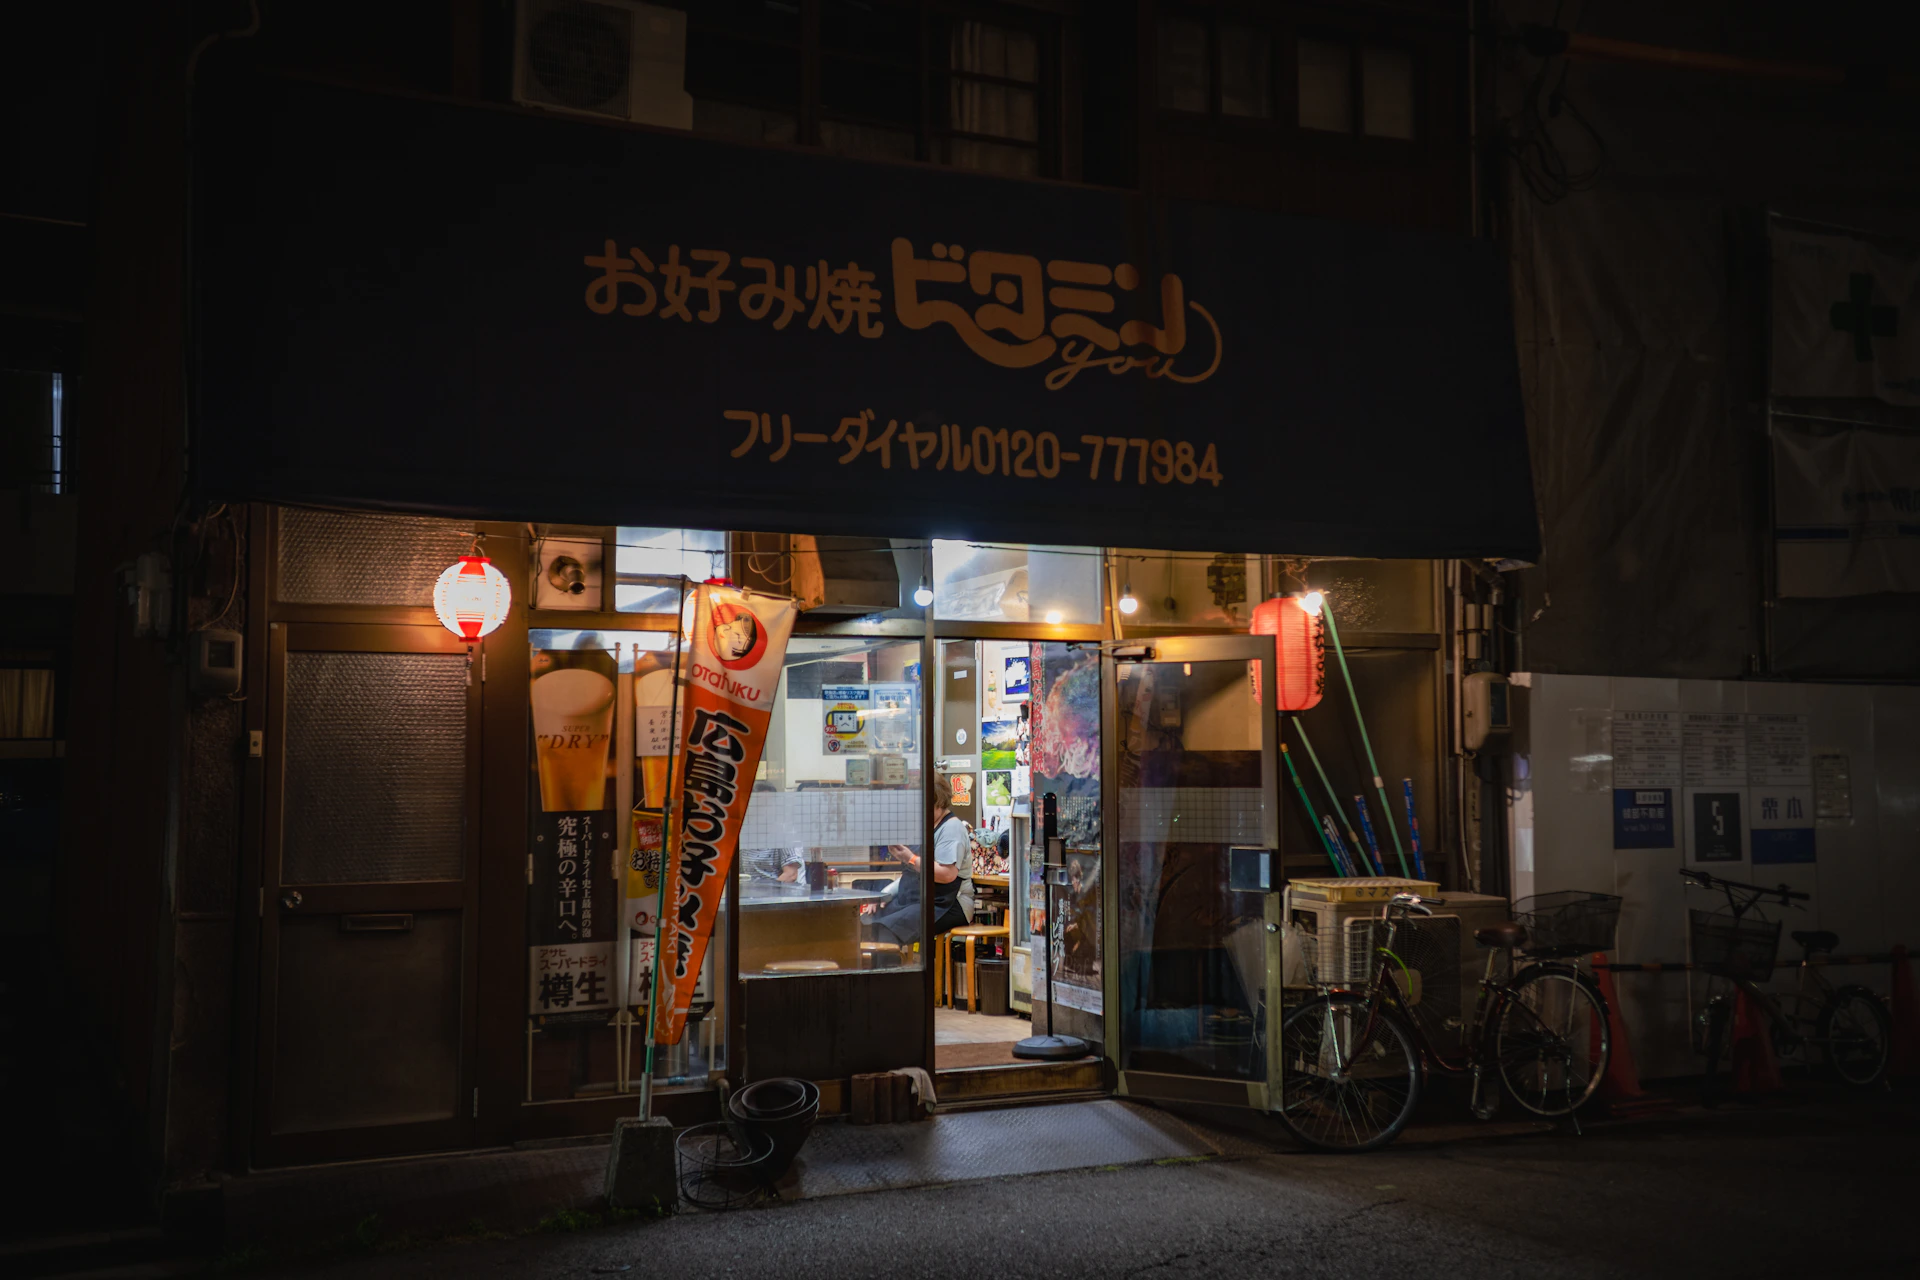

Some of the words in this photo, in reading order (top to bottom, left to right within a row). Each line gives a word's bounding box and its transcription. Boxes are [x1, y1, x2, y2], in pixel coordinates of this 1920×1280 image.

[583, 239, 885, 339] お好み焼
[890, 236, 1187, 368] ビタミン
[1044, 330, 1222, 391] you
[562, 725, 591, 733] SUPER
[581, 816, 592, 938] スーパードライ史上最高の泡
[540, 948, 567, 959] アサヒ
[540, 954, 608, 971] スーパードライ
[538, 971, 609, 1010] 樽生
